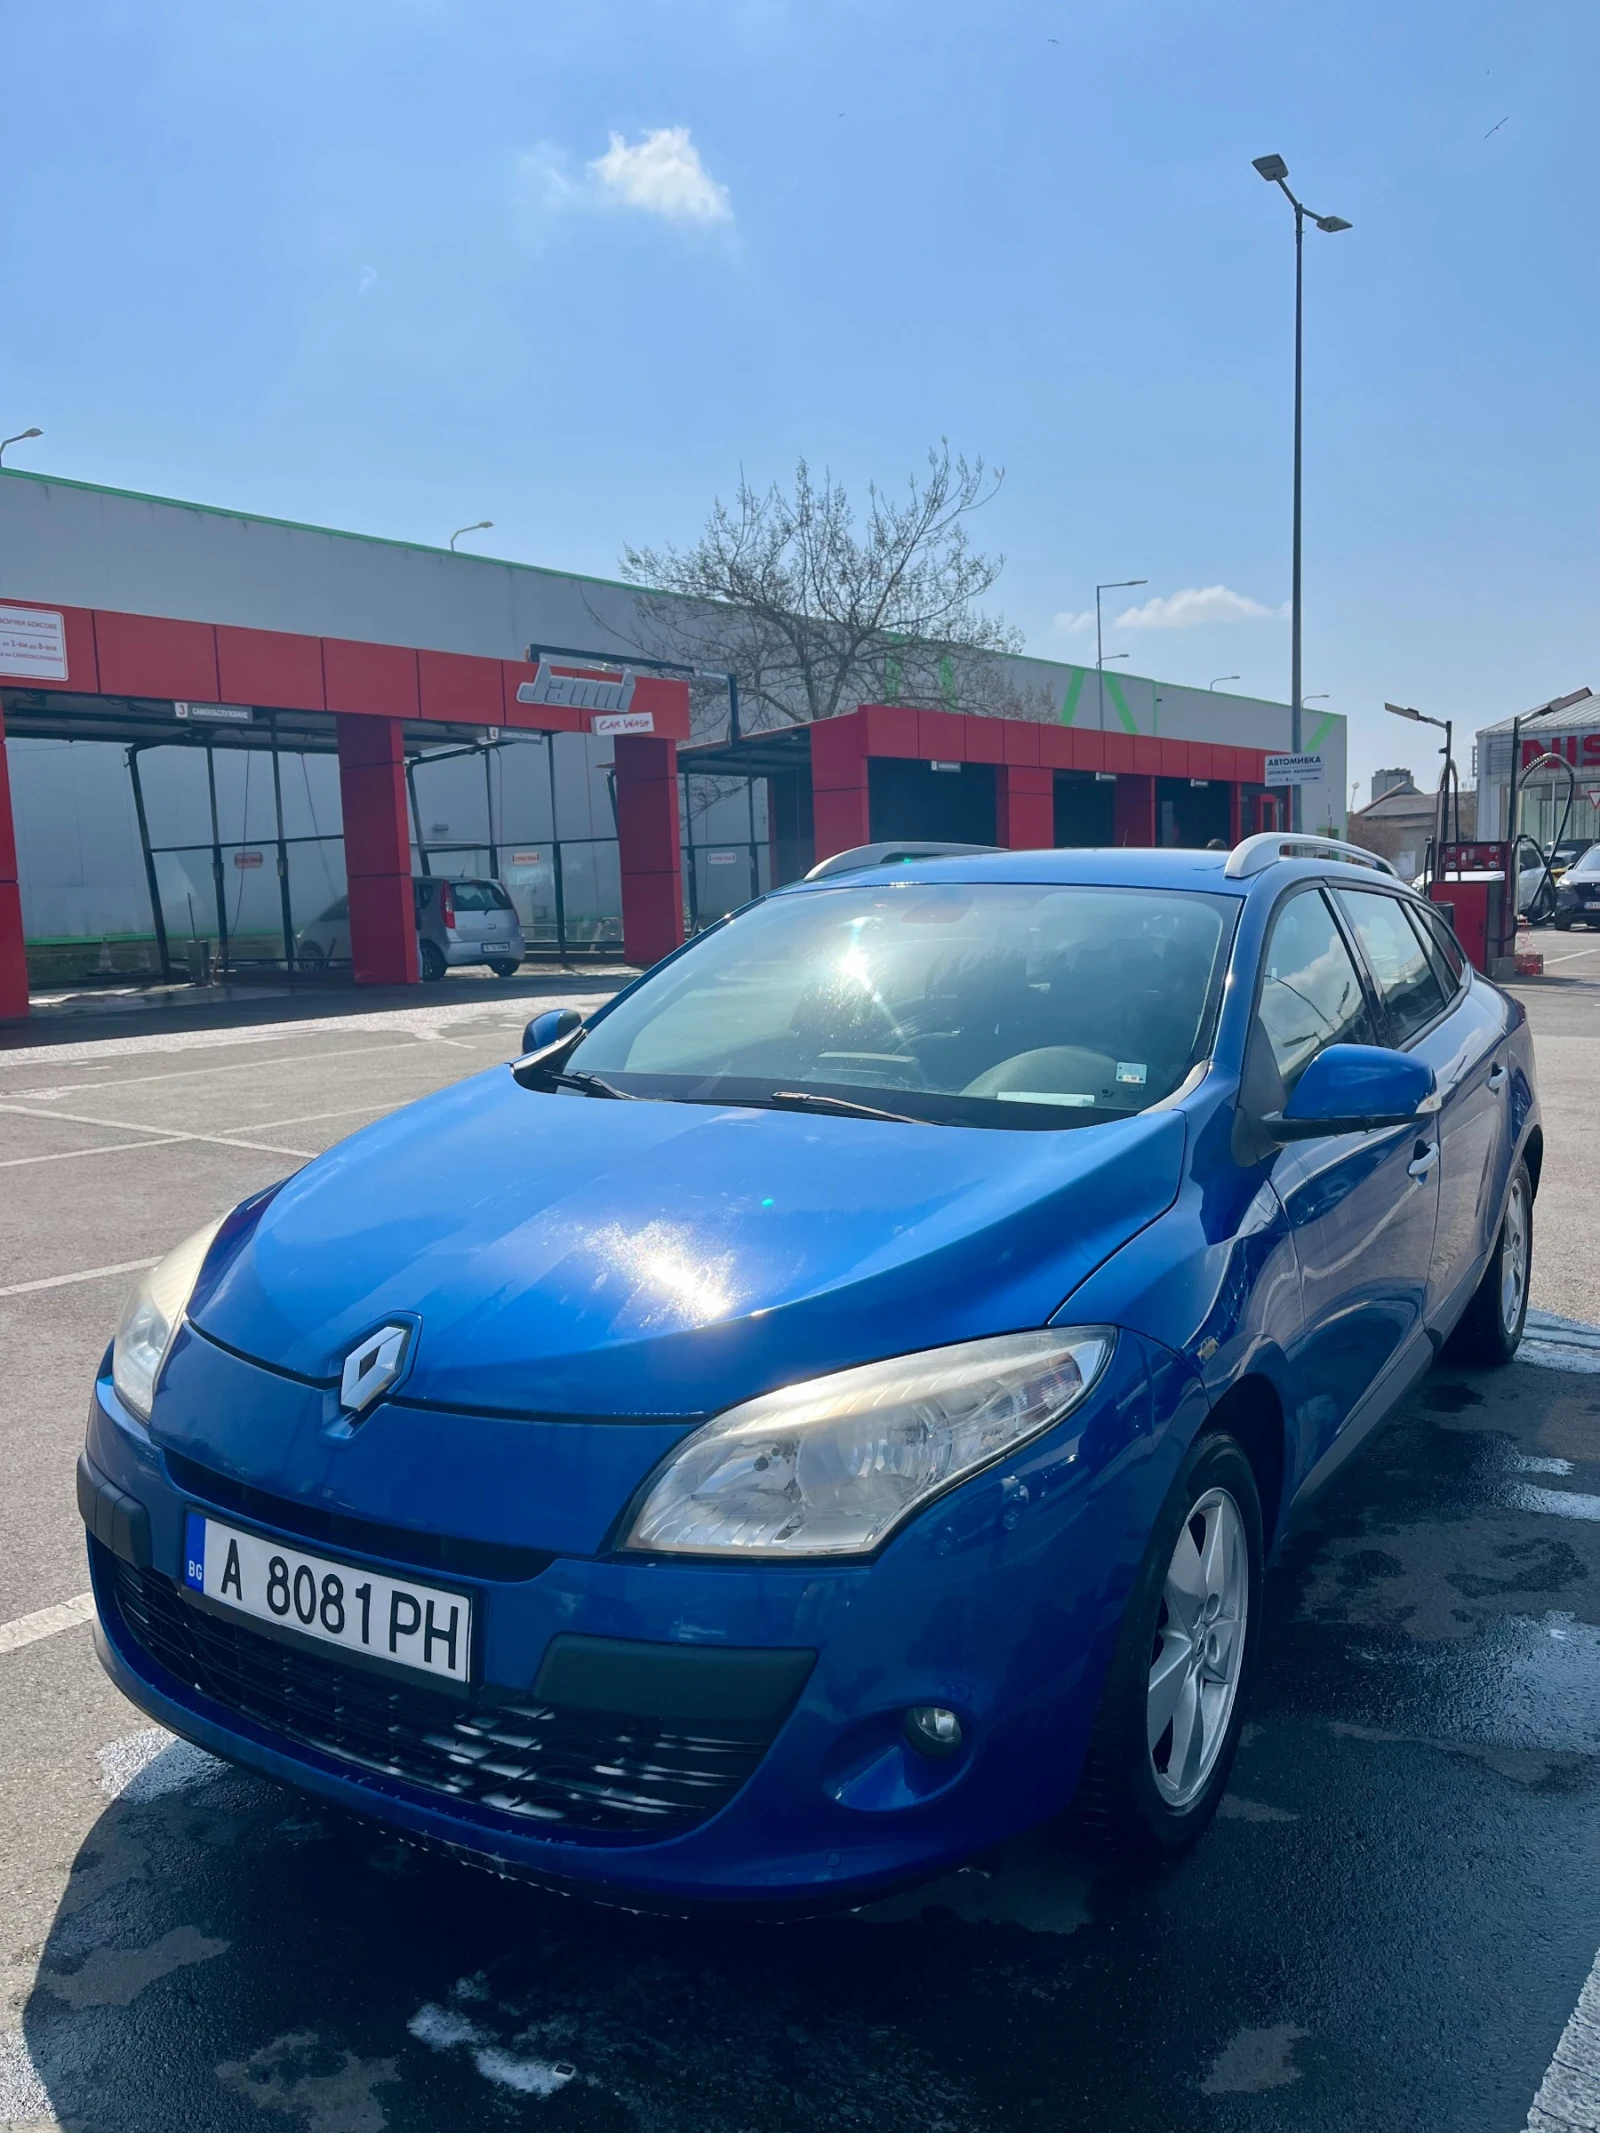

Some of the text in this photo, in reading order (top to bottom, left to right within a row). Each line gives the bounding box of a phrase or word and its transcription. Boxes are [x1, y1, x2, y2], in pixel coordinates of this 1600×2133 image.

[178, 704, 185, 715] 3
[599, 718, 651, 731] CAR WASH
[1268, 756, 1321, 766] АВТОМИВКА
[188, 1559, 203, 1581] BG
[220, 1538, 459, 1671] A 8081 PH
